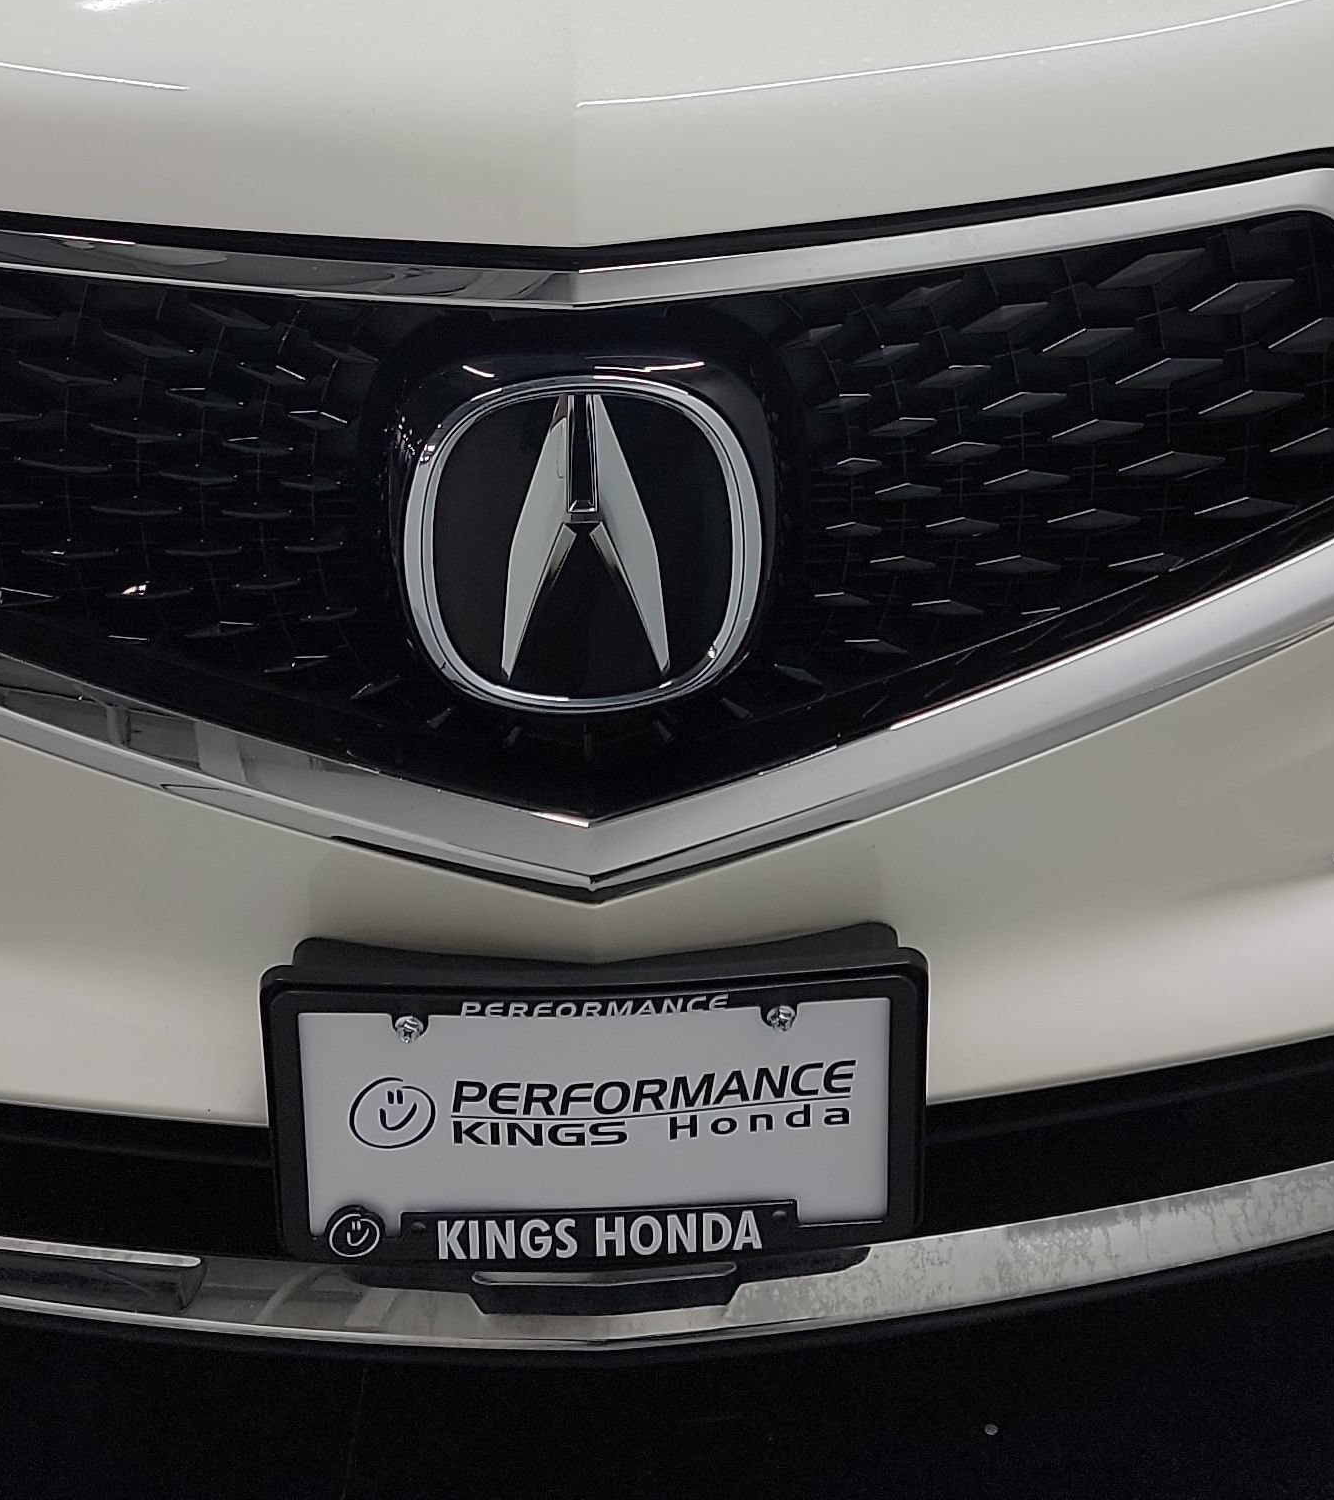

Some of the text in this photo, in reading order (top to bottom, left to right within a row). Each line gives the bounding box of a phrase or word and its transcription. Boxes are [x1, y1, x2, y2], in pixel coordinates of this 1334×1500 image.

[461, 993, 729, 1019] PERFORMANCE
[453, 1060, 856, 1116] PERFORMANCE
[452, 1104, 851, 1147] KINGS Honda
[437, 1211, 763, 1260] KINGS HONDA
